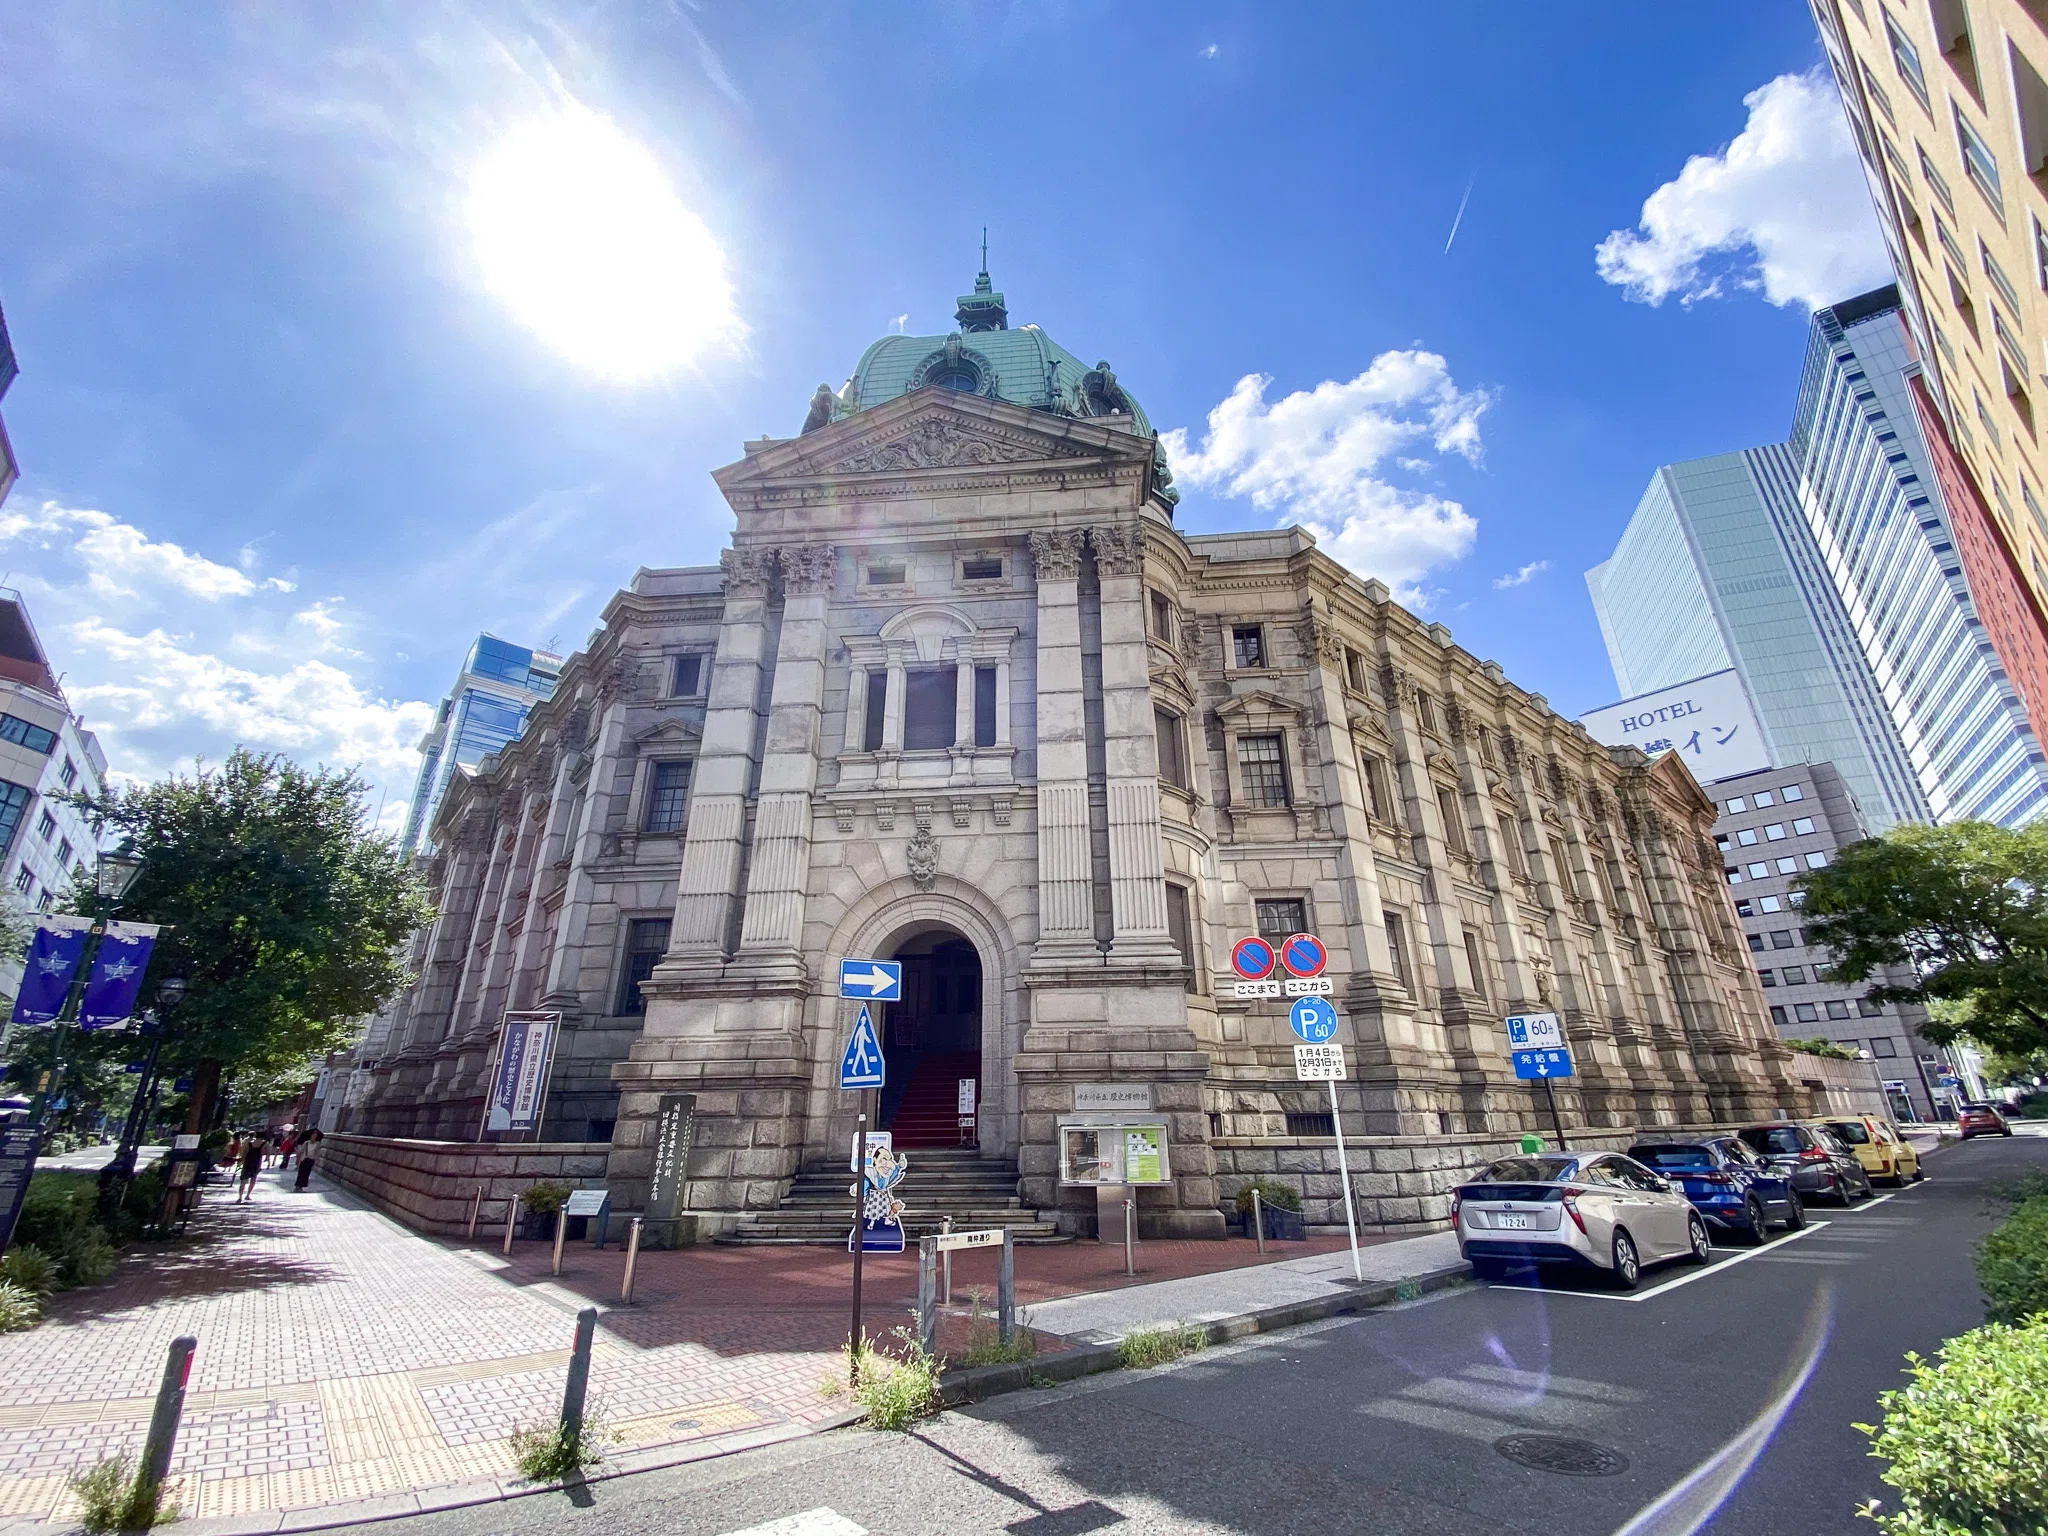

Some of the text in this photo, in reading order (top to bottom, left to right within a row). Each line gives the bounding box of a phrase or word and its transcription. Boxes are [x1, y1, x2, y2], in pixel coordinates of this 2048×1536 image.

[1620, 700, 1702, 733] HOTEL
[1237, 984, 1277, 995] ここまで
[1288, 981, 1330, 992] ここから
[1300, 1008, 1319, 1038] P
[1512, 1019, 1522, 1035] P
[502, 1031, 523, 1105] かながわの歴史と文化
[520, 1031, 543, 1112] 神奈川県立歴史博物館
[1505, 1218, 1526, 1228] 12-24
